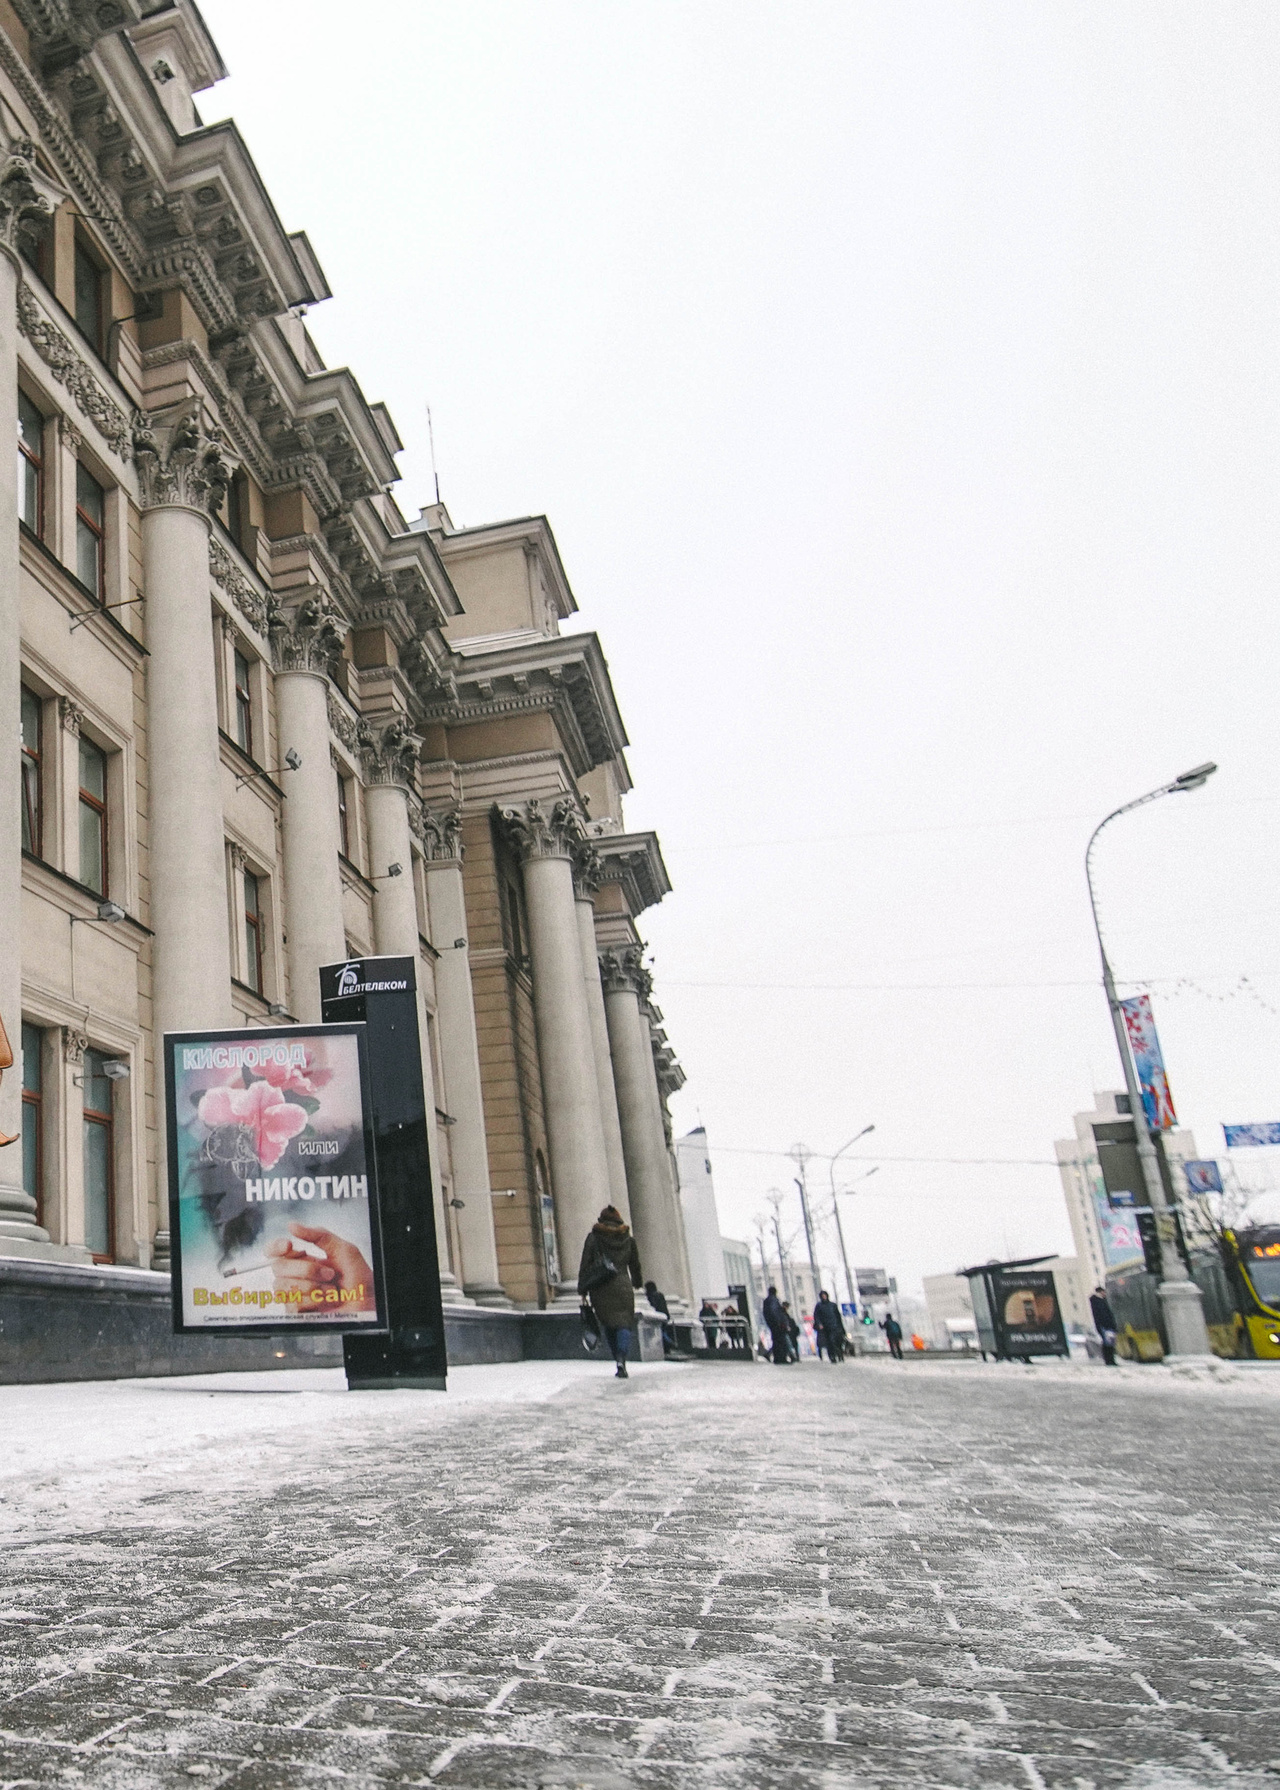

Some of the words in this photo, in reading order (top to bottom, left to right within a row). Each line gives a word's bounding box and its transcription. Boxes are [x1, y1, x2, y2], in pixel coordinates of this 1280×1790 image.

[343, 980, 407, 995] БЕЛТЕЛЕКОМ
[183, 1043, 307, 1070] КИСЛОРОД
[245, 1174, 368, 1202] НИКОТИН
[193, 1285, 303, 1308] Выбирай
[311, 1283, 365, 1303] сам!
